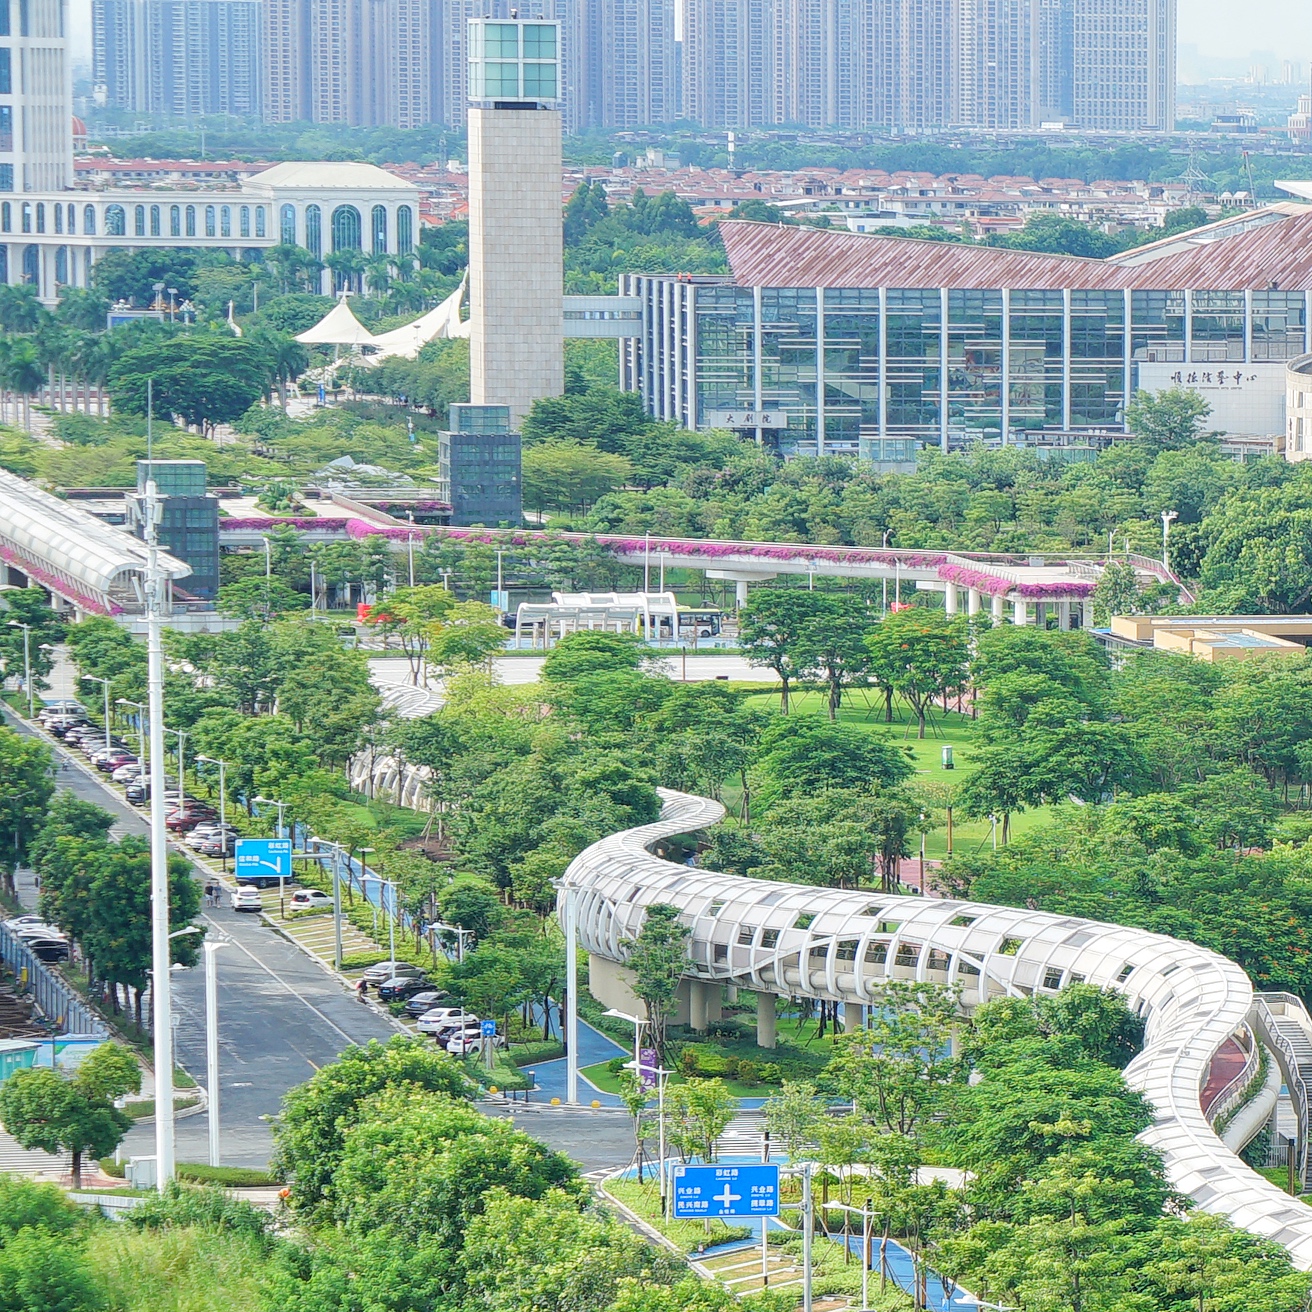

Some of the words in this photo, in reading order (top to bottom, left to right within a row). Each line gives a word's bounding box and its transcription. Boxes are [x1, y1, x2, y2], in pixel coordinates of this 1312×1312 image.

[715, 1169, 739, 1177] 彩虹路
[677, 1187, 701, 1195] 兴业路
[750, 1186, 774, 1194] 兴业路
